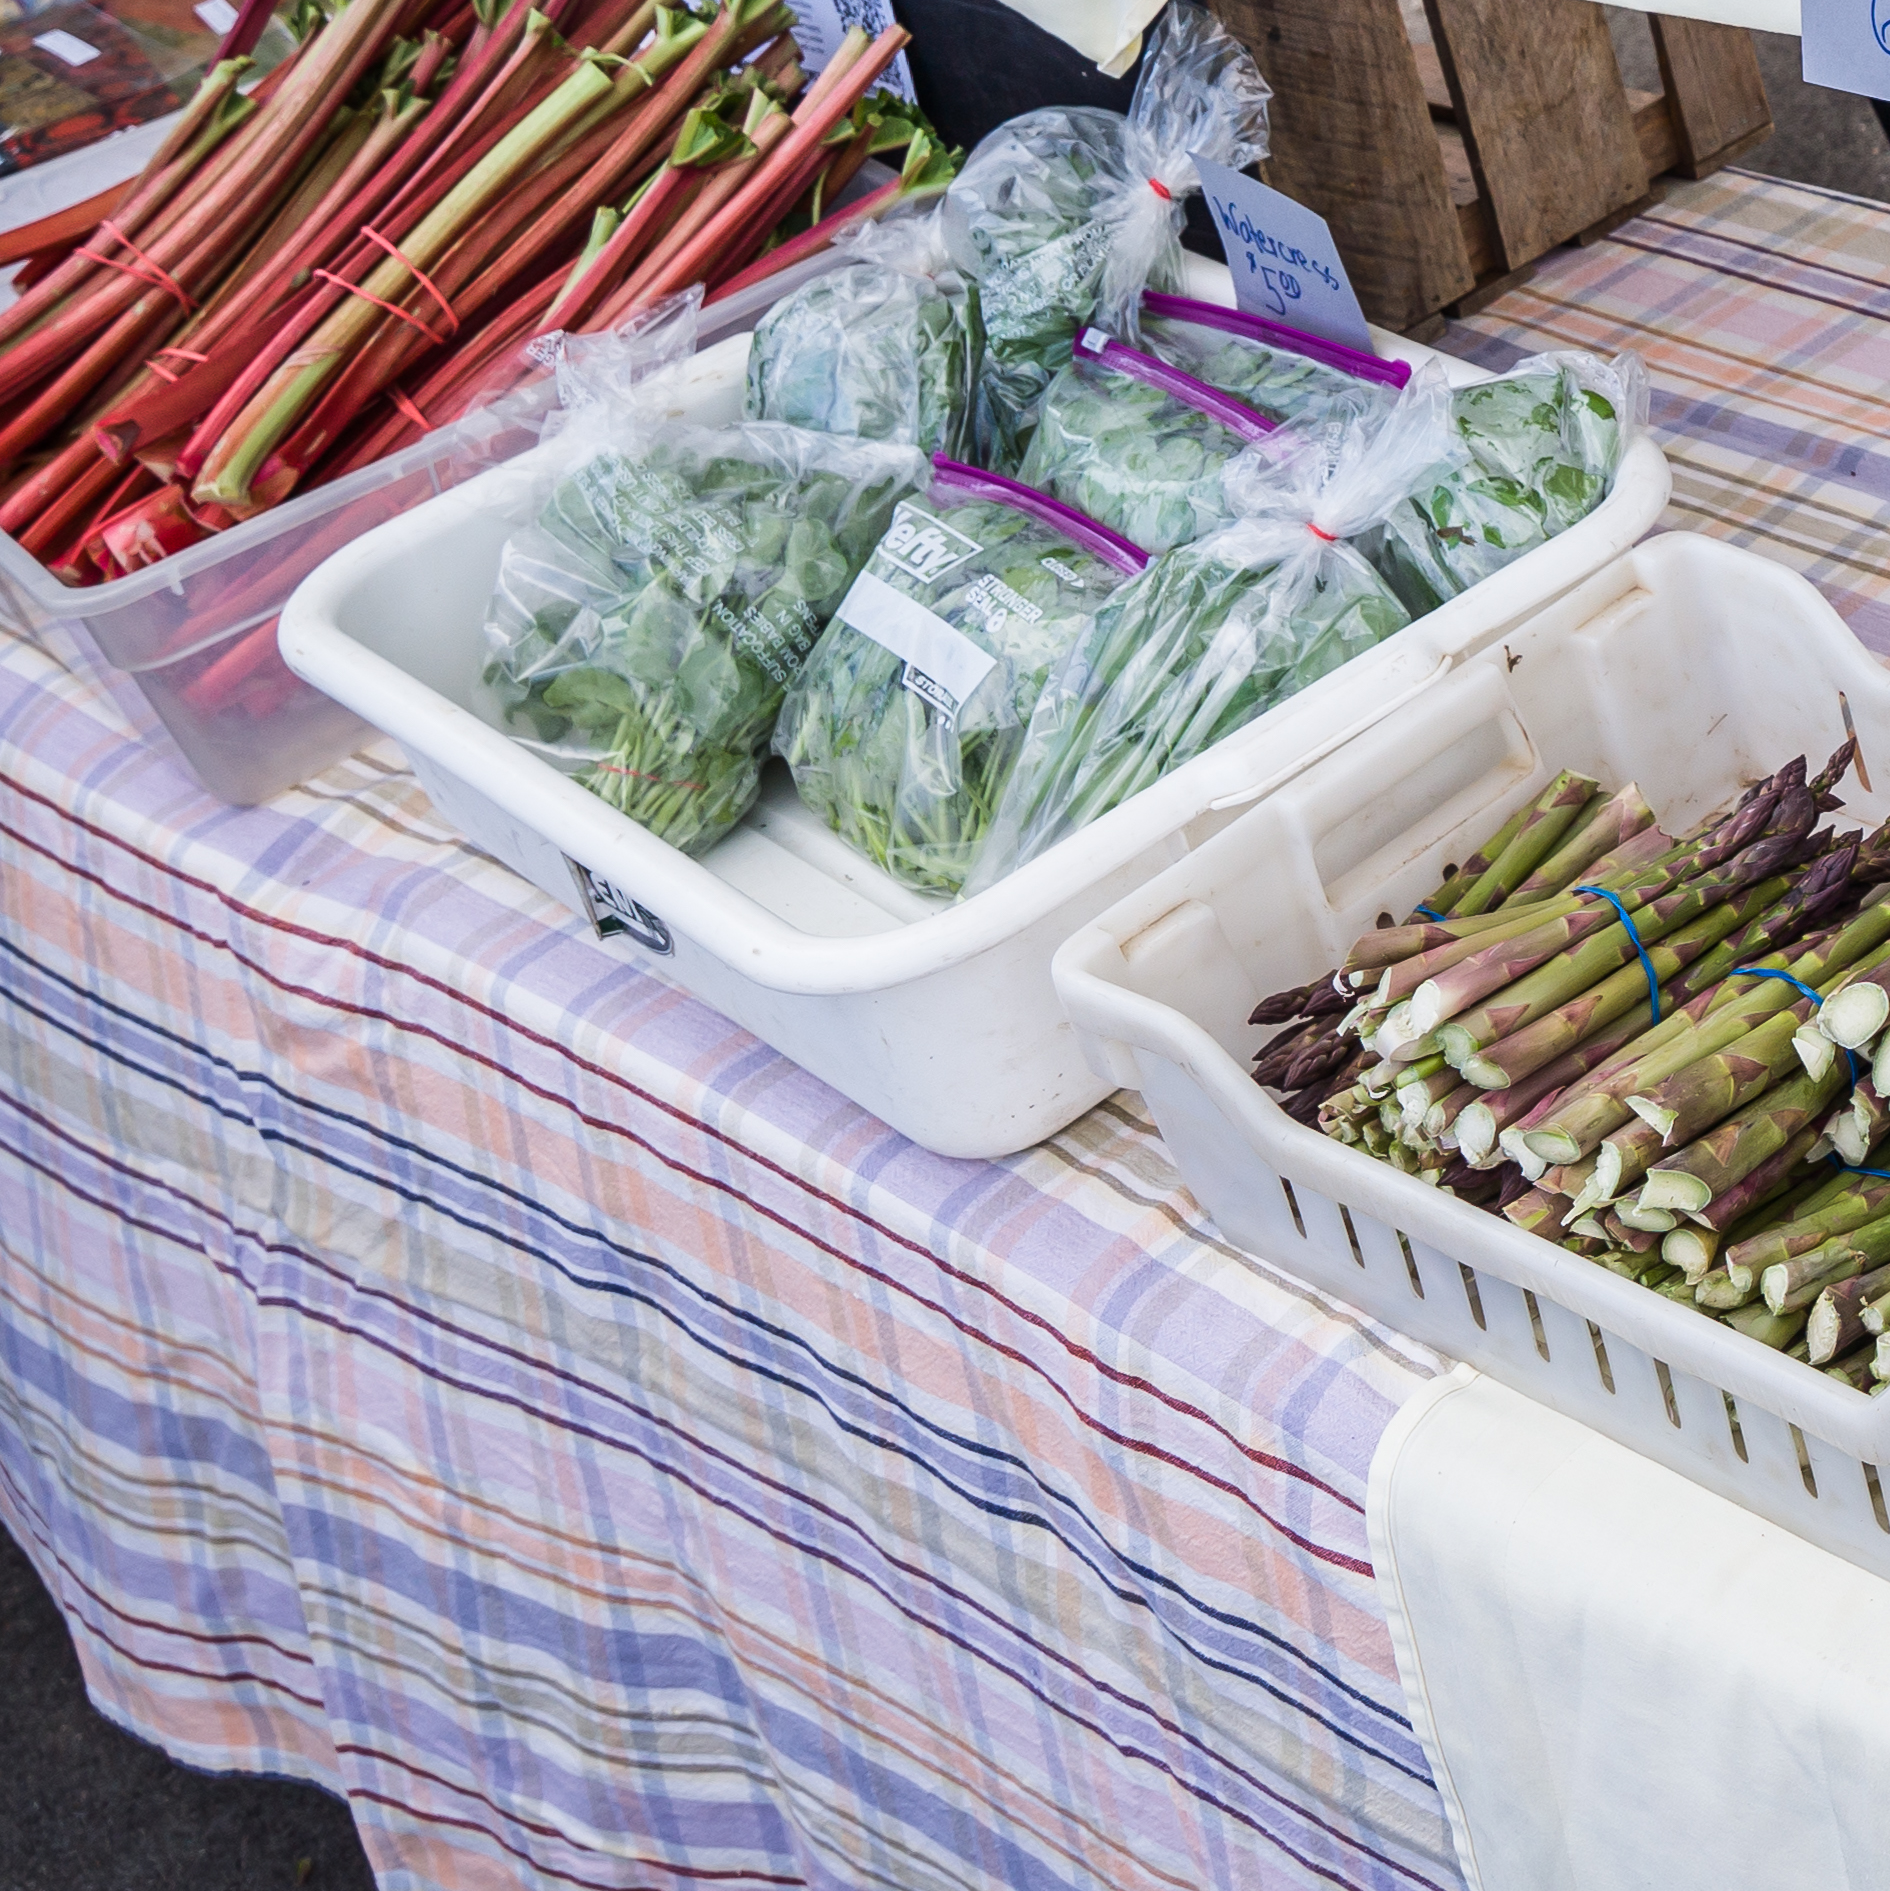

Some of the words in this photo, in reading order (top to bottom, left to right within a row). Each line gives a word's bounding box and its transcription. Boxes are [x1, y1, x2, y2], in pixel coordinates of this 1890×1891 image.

[1212, 195, 1340, 291] Watercress
[978, 573, 1044, 624] STRONGER
[743, 604, 785, 650] BABIES
[787, 624, 812, 651] BAG
